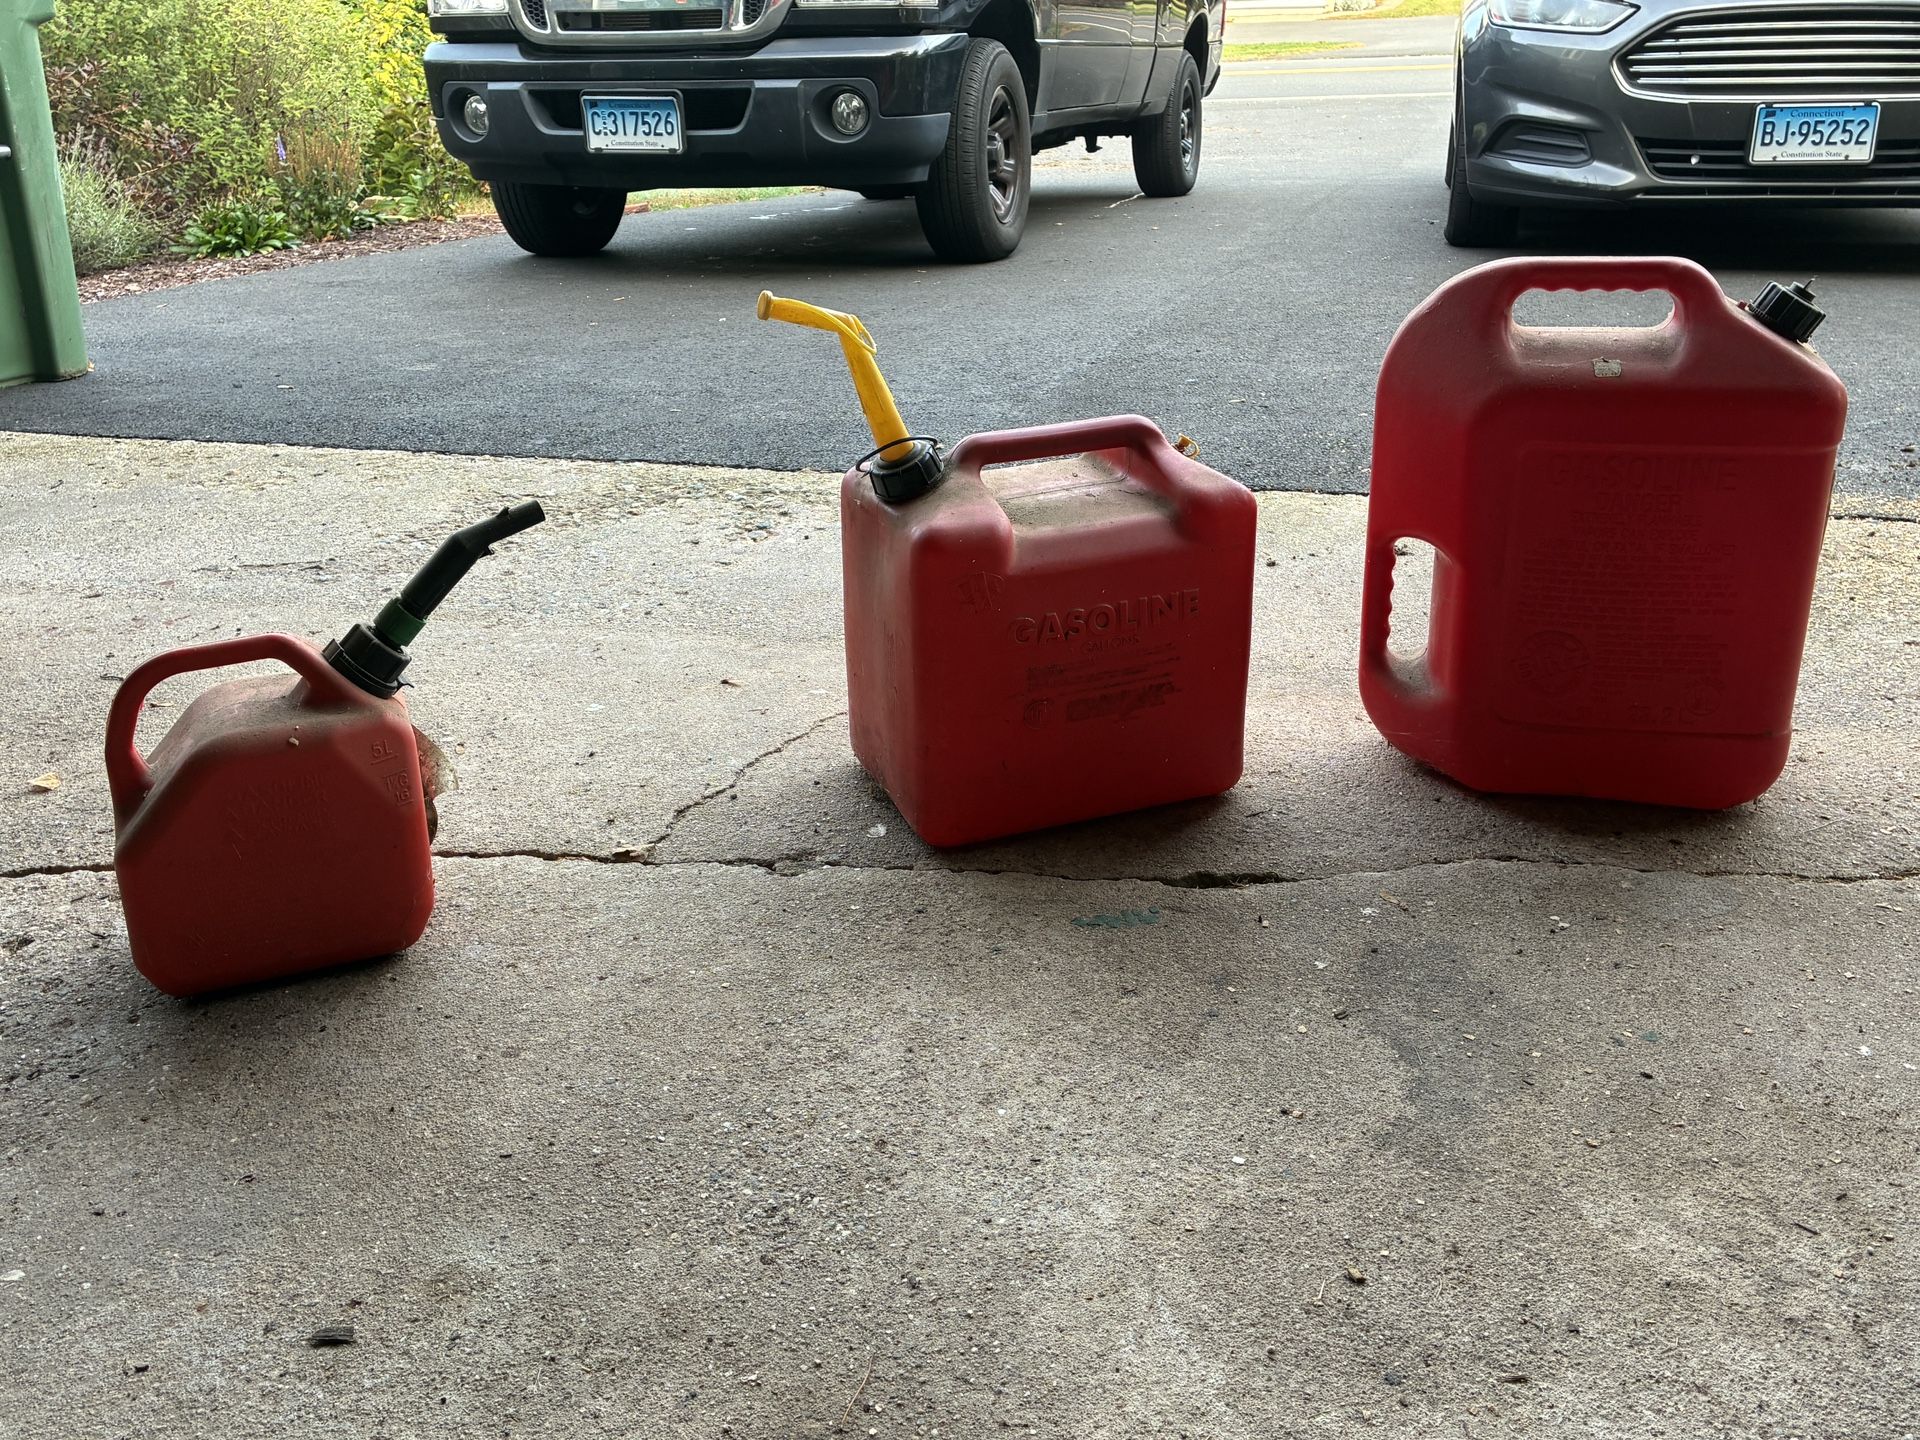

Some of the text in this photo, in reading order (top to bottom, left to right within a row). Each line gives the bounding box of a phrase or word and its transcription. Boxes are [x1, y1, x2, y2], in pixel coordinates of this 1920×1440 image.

[1790, 109, 1845, 118] Connecticut
[1780, 150, 1843, 158] Constitution State
[1548, 453, 1739, 492] GASOLINE
[1008, 588, 1200, 647] GASOLINE
